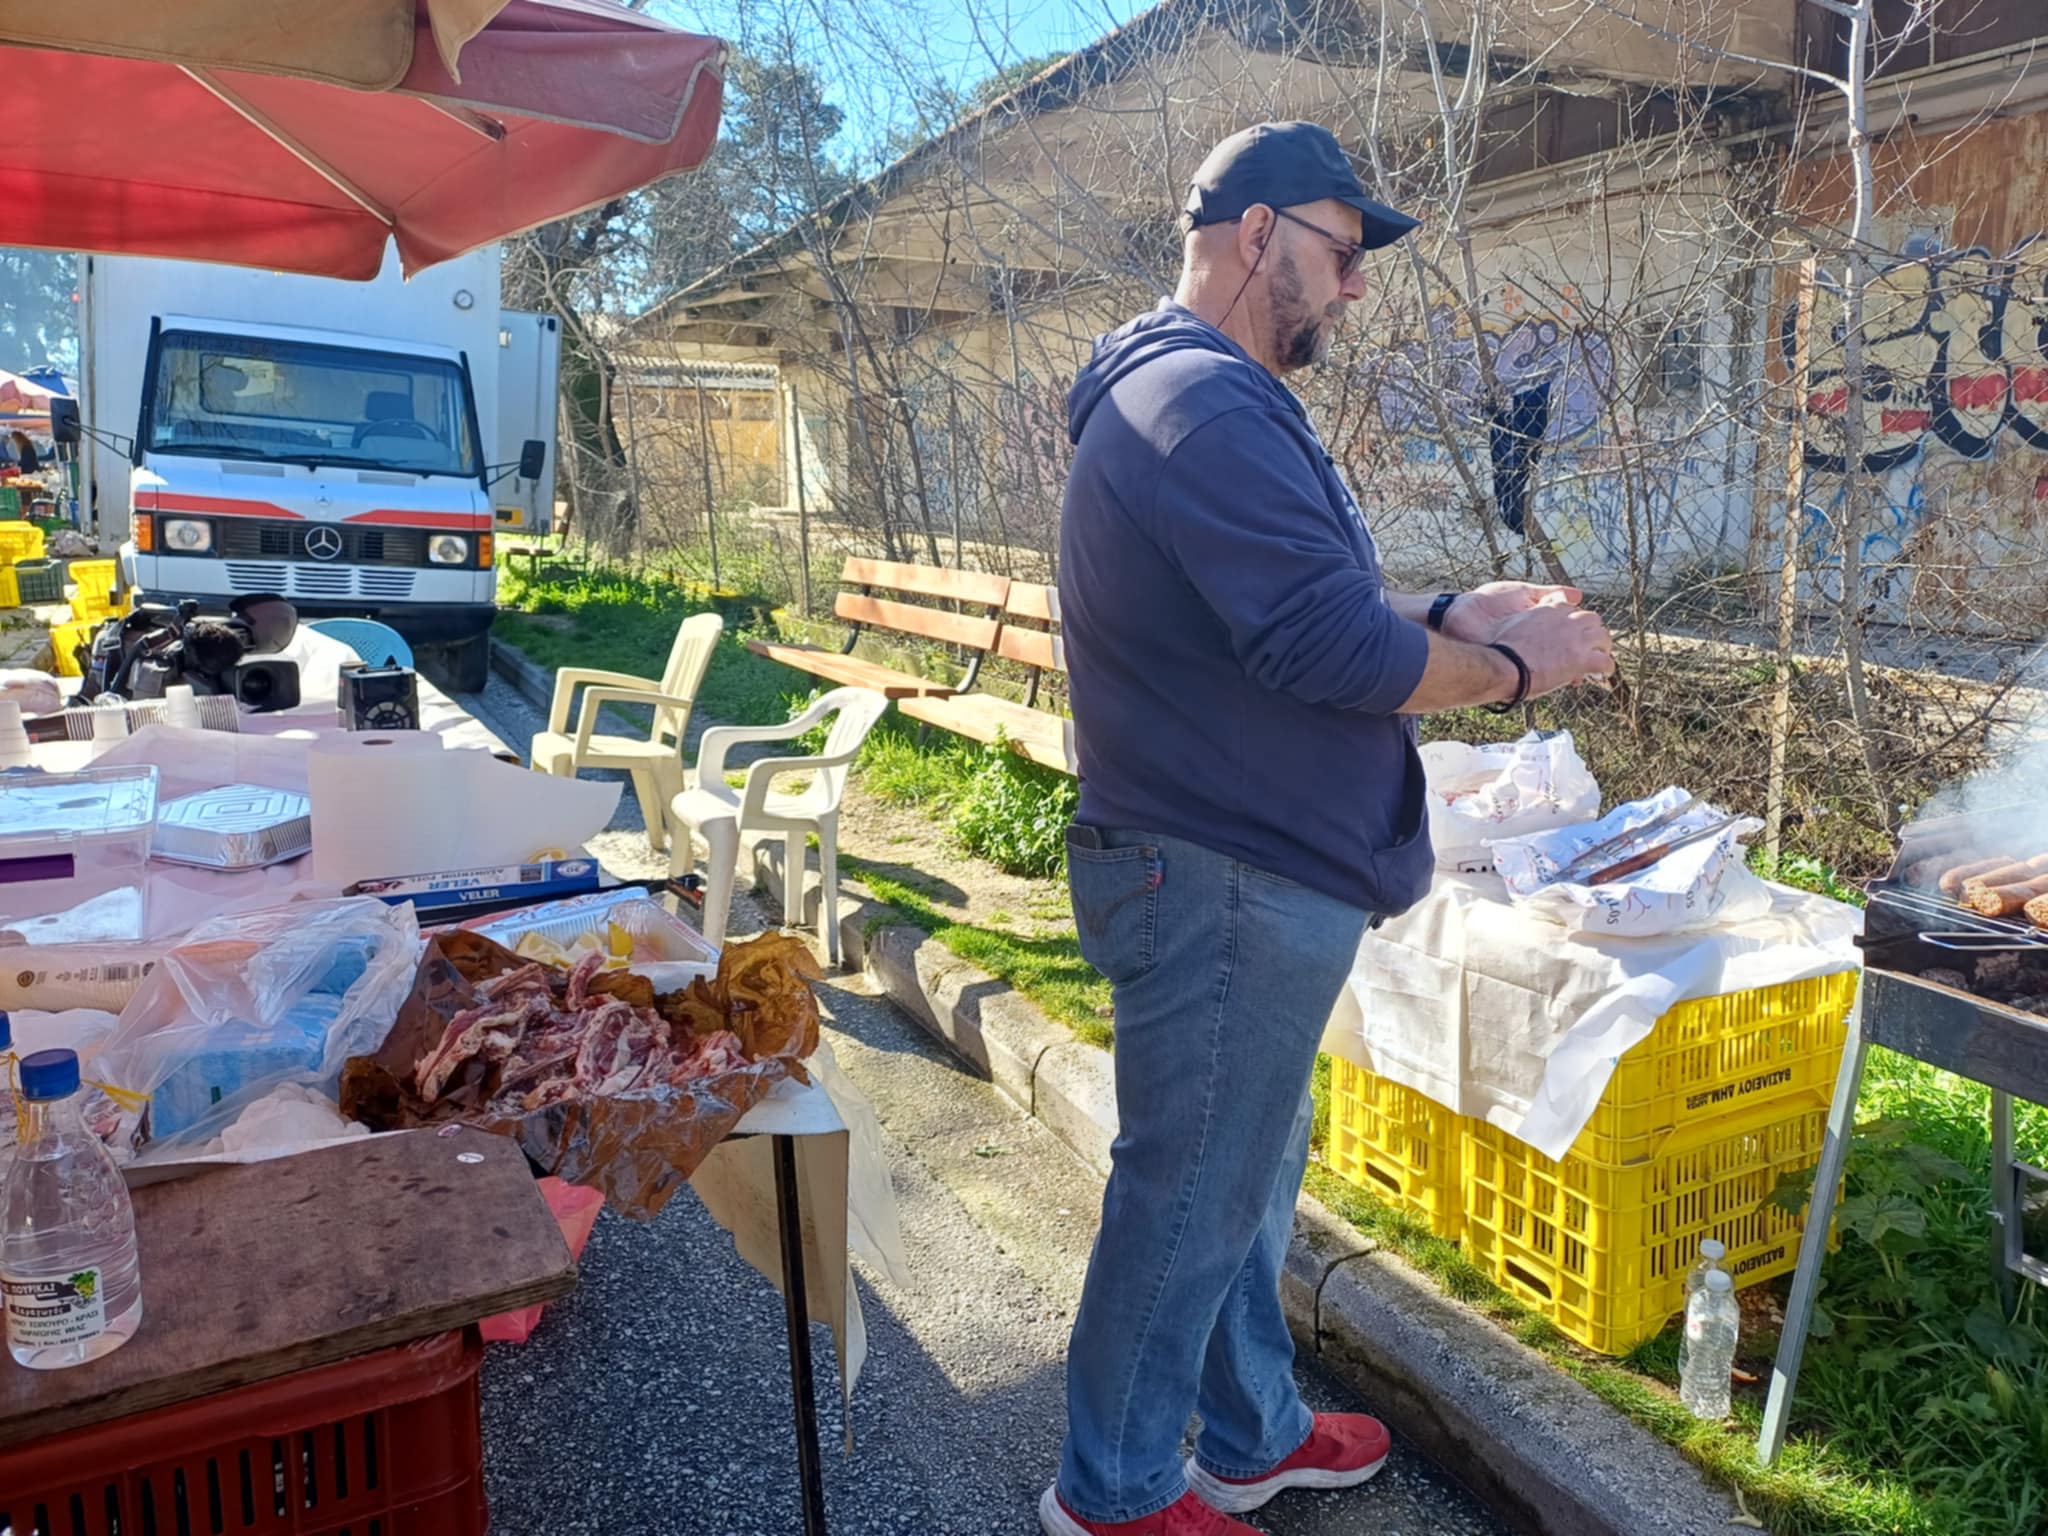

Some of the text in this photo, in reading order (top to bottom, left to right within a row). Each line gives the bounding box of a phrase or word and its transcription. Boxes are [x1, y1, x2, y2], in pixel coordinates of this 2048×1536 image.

[428, 878, 481, 891] VELER
[458, 888, 500, 903] VELER
[1737, 1068, 1792, 1096] ΒΑΣΙΛΕΙΟΥ
[1733, 1246, 1785, 1275] ΒΑΣΙΛΕΙΟΥ
